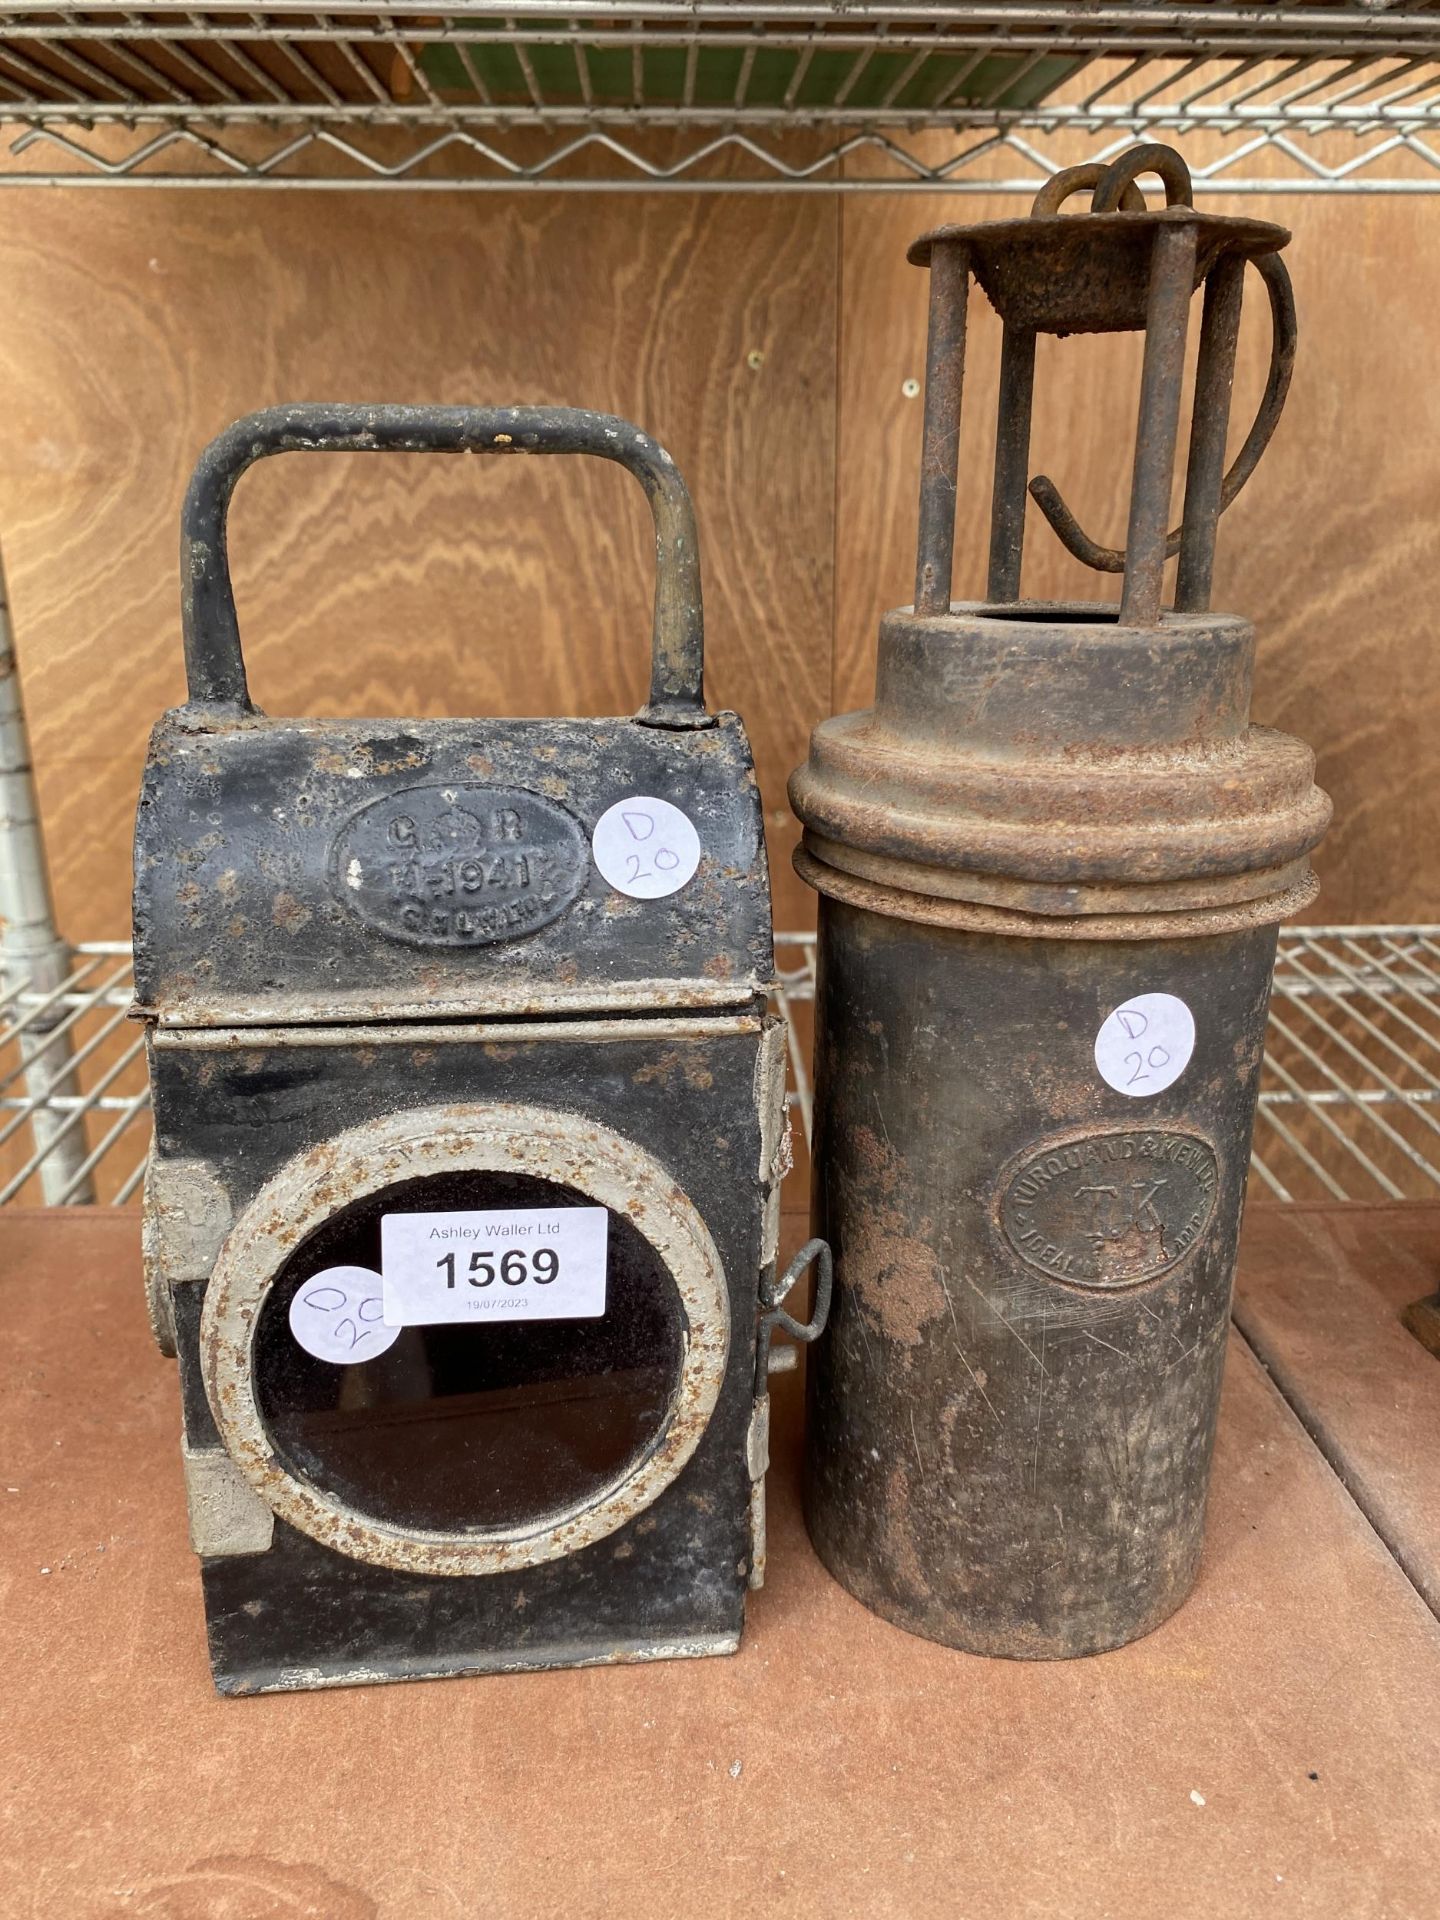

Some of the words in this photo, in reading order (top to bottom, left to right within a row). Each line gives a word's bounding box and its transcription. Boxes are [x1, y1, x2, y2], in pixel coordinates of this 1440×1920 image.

[621, 811, 655, 841] D
[625, 847, 680, 884] 20
[1115, 1009, 1149, 1040] D
[1123, 1044, 1171, 1086] 20
[429, 1225, 481, 1241] Ashley
[485, 1224, 532, 1238] Waller
[537, 1222, 561, 1236] Ltd
[436, 1248, 560, 1289] 1569
[466, 1298, 529, 1310] 19/07/2023
